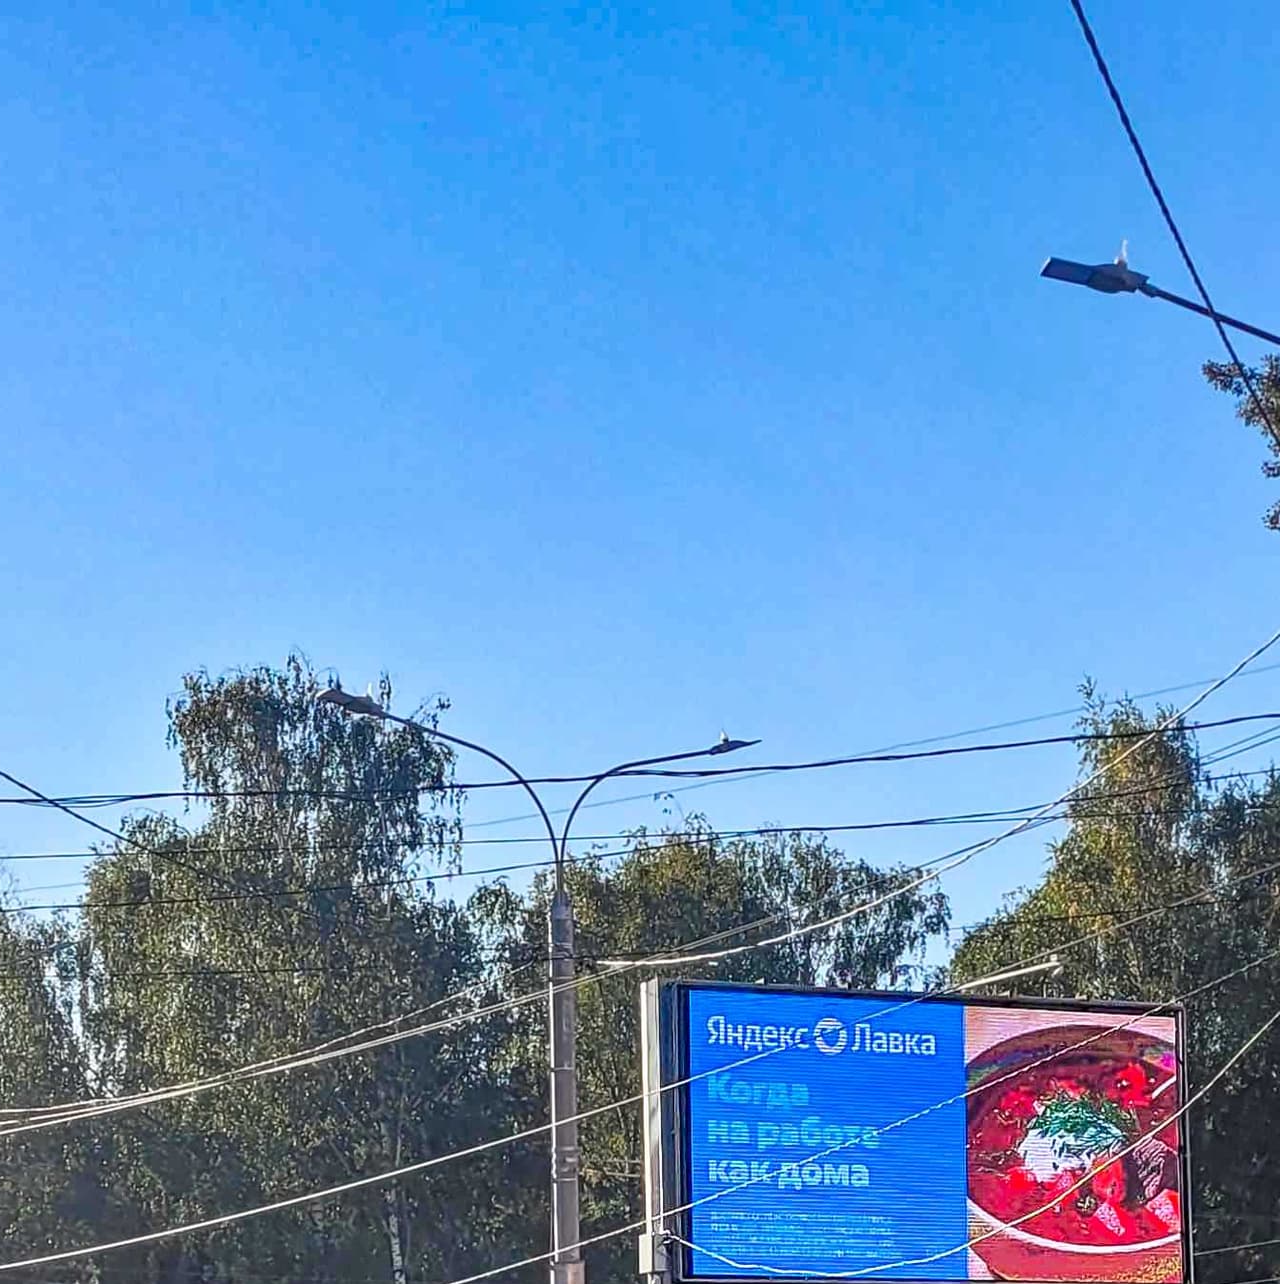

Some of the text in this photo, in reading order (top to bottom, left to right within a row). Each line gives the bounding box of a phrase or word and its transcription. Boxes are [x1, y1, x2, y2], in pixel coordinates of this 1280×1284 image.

[707, 1015, 936, 1055] Яндекс Лавка
[707, 1074, 809, 1110] Когда
[707, 1116, 880, 1151] на работе
[708, 1159, 870, 1190] как дома
